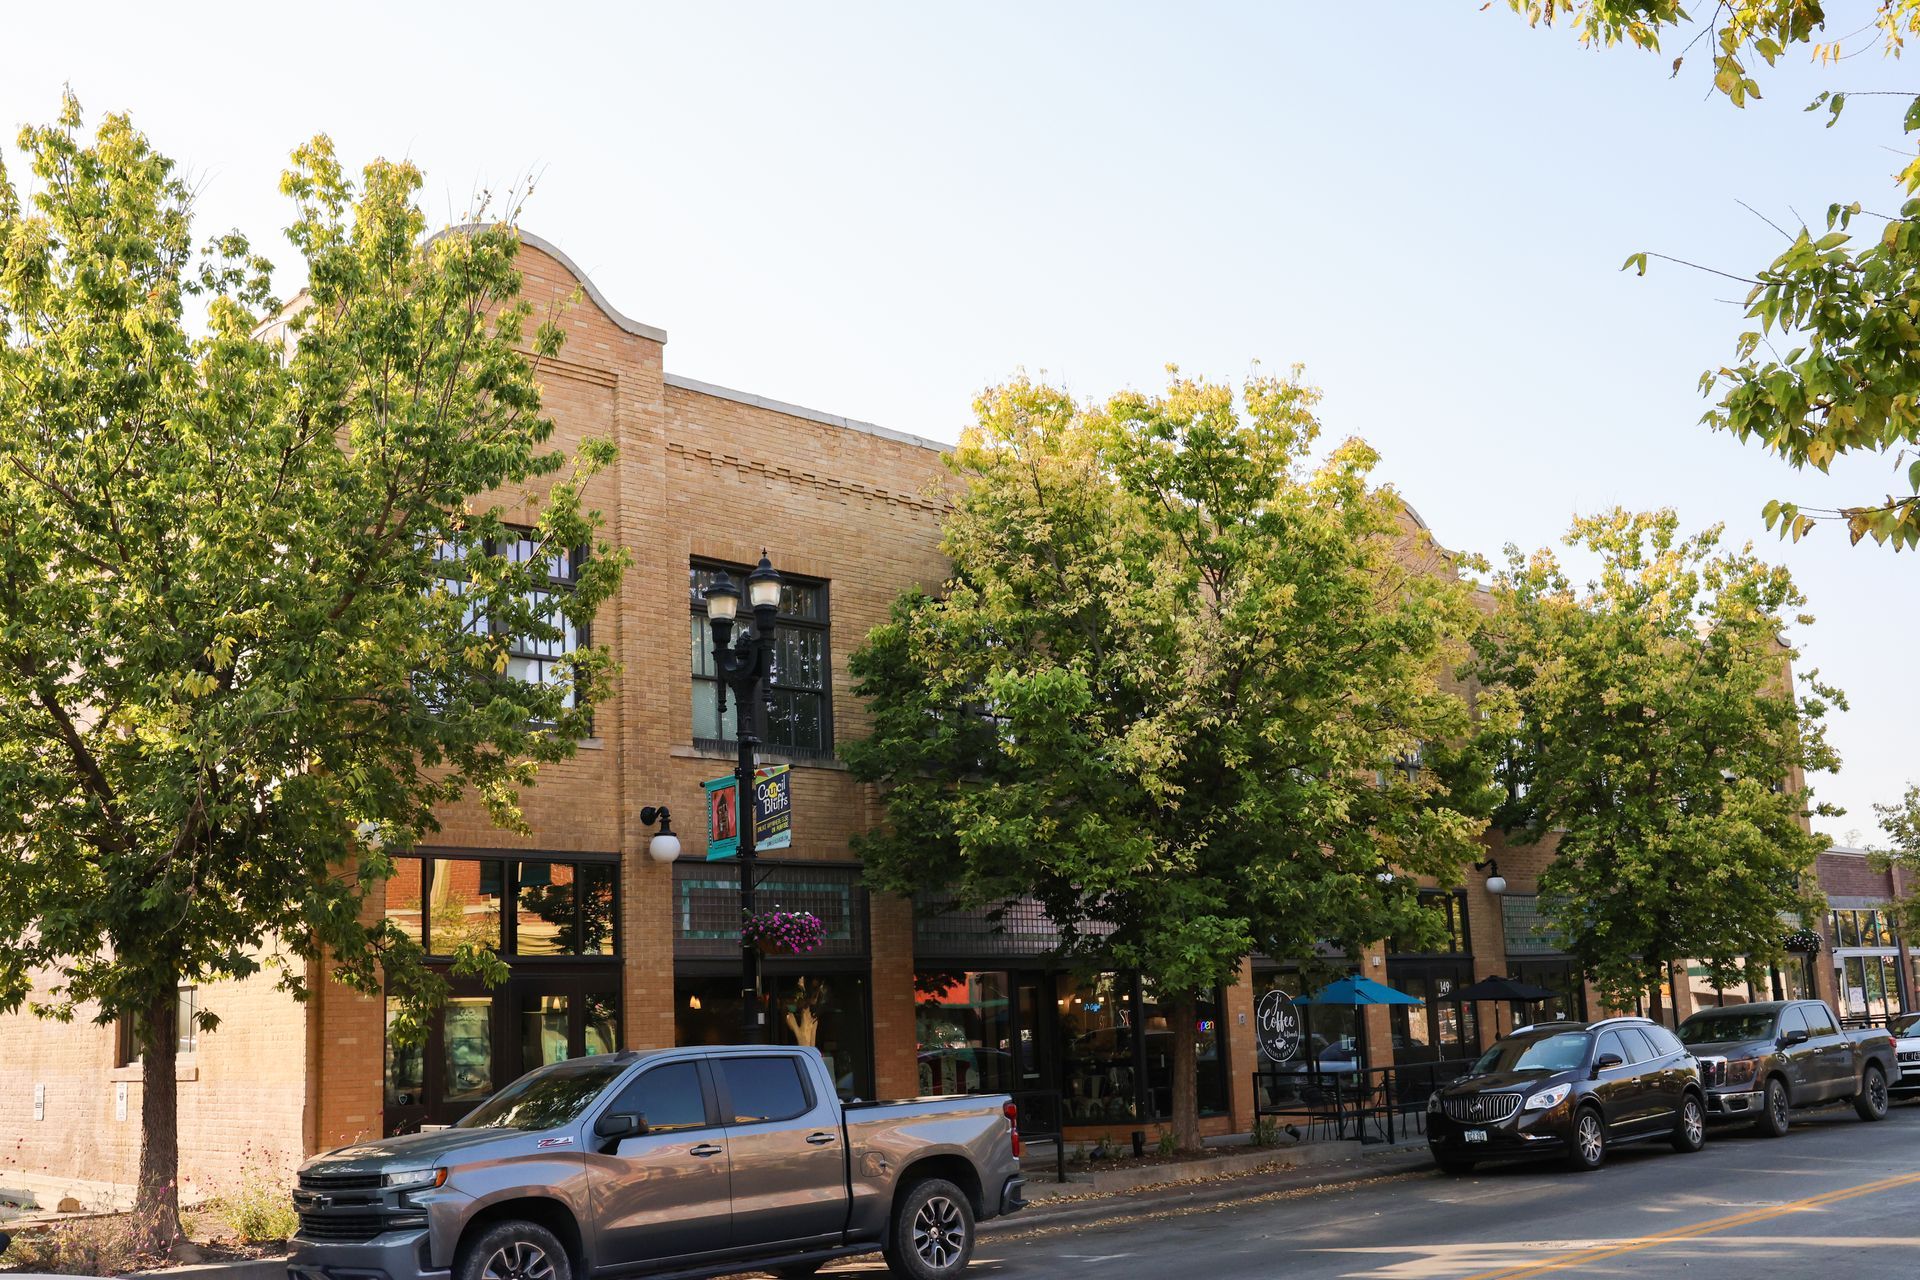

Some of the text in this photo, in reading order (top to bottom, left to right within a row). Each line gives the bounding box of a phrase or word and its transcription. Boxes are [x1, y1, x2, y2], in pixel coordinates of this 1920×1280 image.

[758, 774, 786, 800] Council
[763, 792, 788, 814] Bluffs
[1440, 981, 1450, 993] 149
[1262, 1009, 1295, 1032] Coffee
